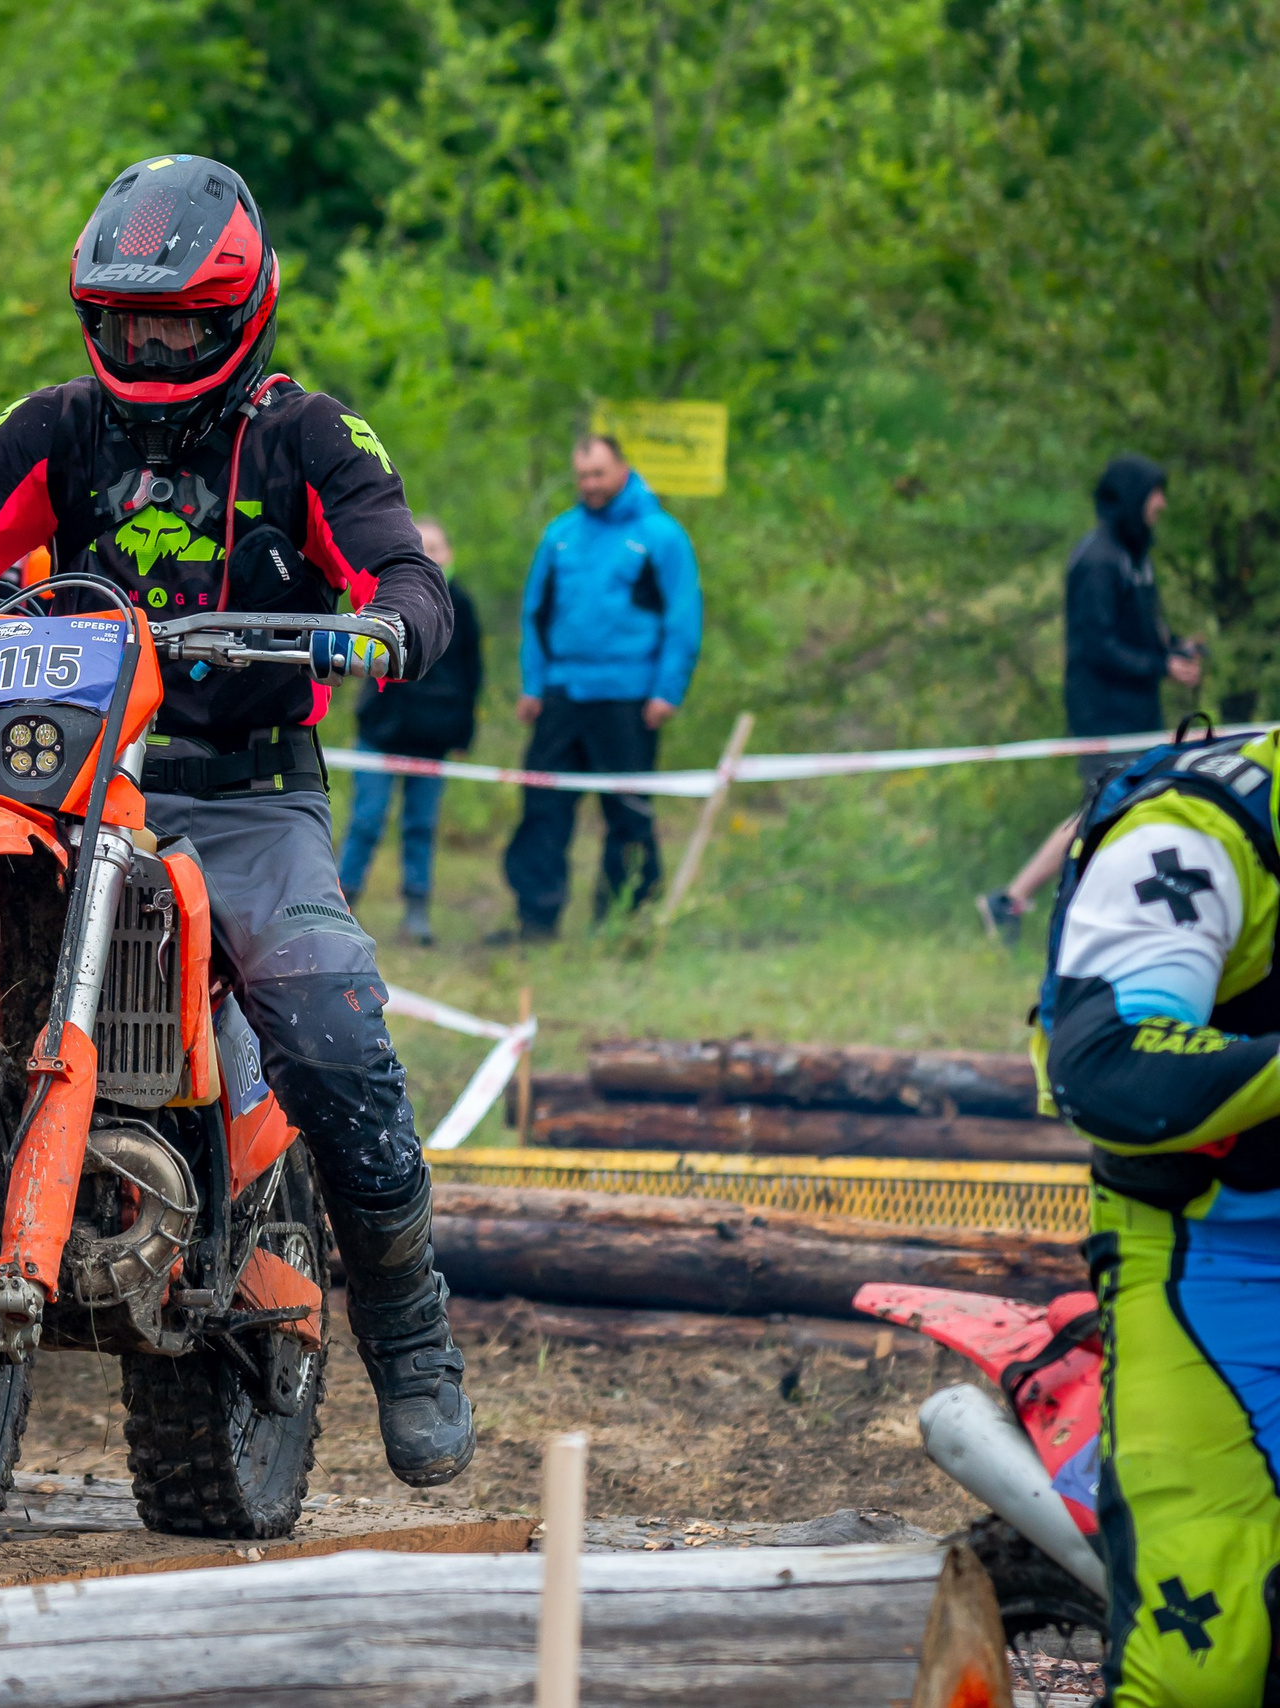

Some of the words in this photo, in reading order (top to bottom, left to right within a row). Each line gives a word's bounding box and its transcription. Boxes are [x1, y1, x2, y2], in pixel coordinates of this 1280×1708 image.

[244, 614, 321, 625] ZETA
[70, 620, 120, 632] СЕРЕБРО
[91, 635, 118, 643] САМАРА
[231, 1028, 262, 1097] 115
